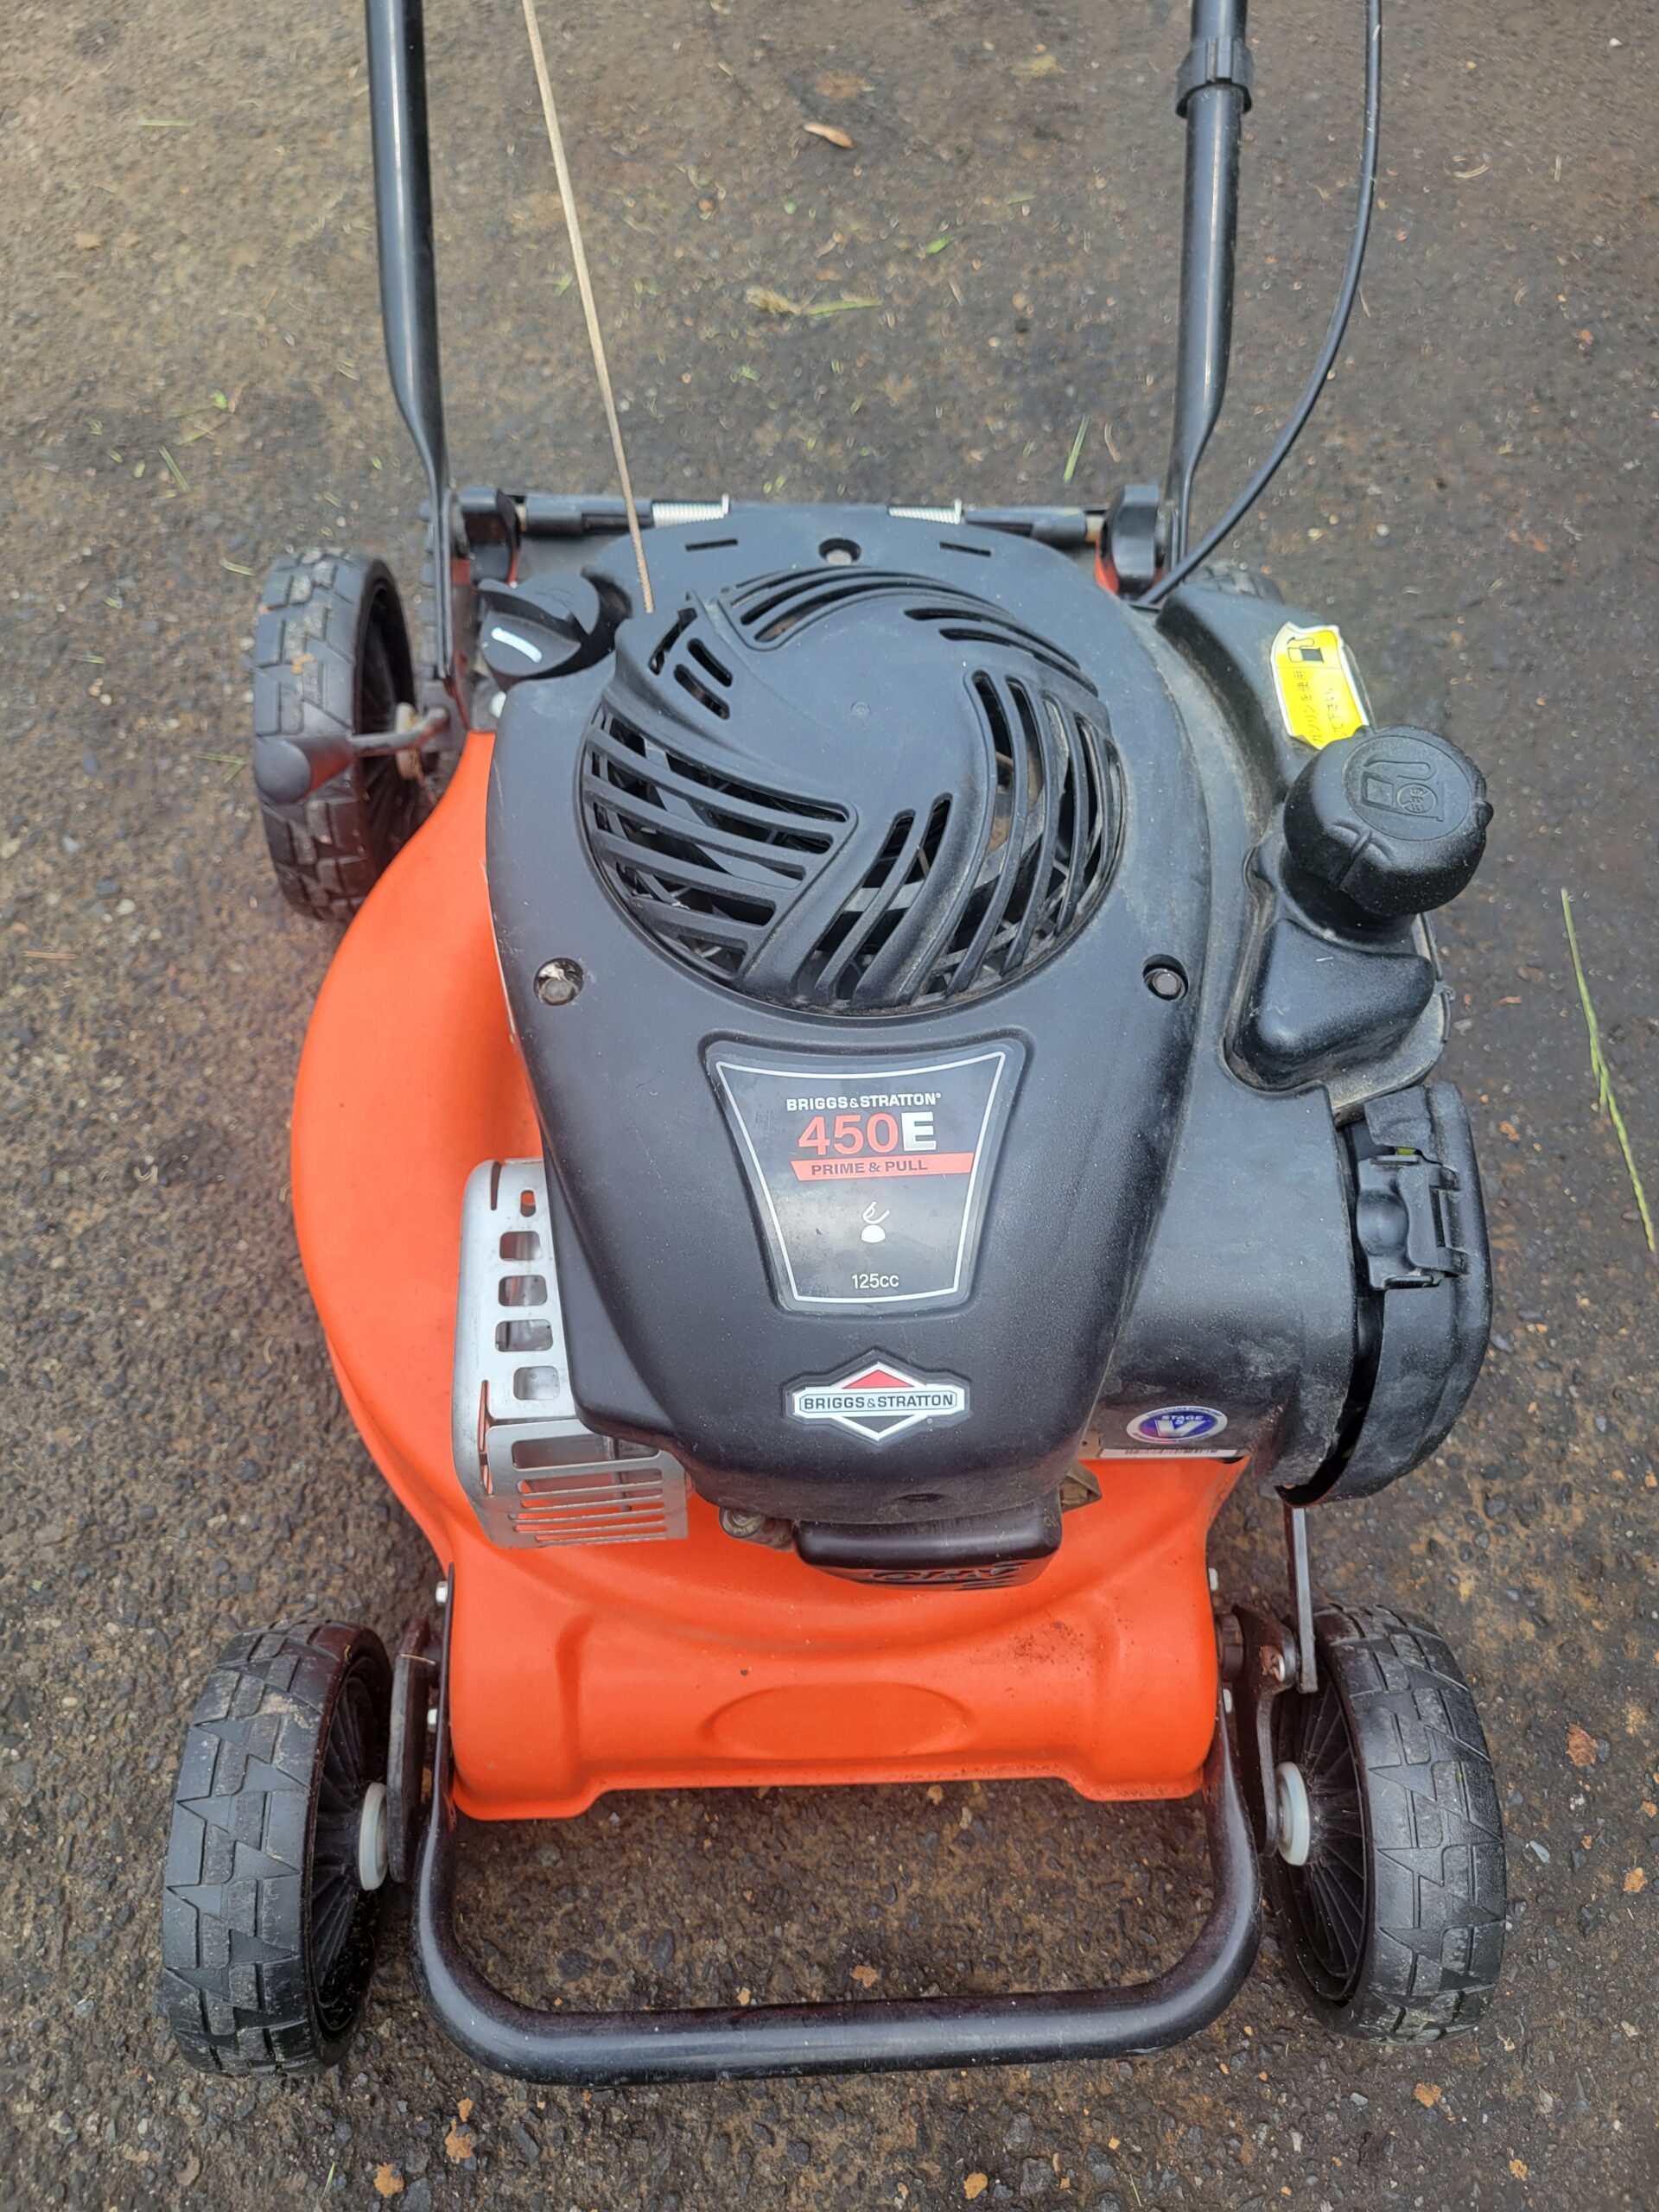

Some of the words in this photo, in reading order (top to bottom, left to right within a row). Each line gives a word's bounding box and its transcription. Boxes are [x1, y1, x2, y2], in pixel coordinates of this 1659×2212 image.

[798, 1111, 937, 1156] 450E
[810, 1162, 865, 1176] PRIME
[868, 1162, 881, 1173] &
[884, 1160, 928, 1172] PULL
[851, 1274, 900, 1289] 125cc
[804, 1394, 954, 1409] BRIGGS&STRATTON
